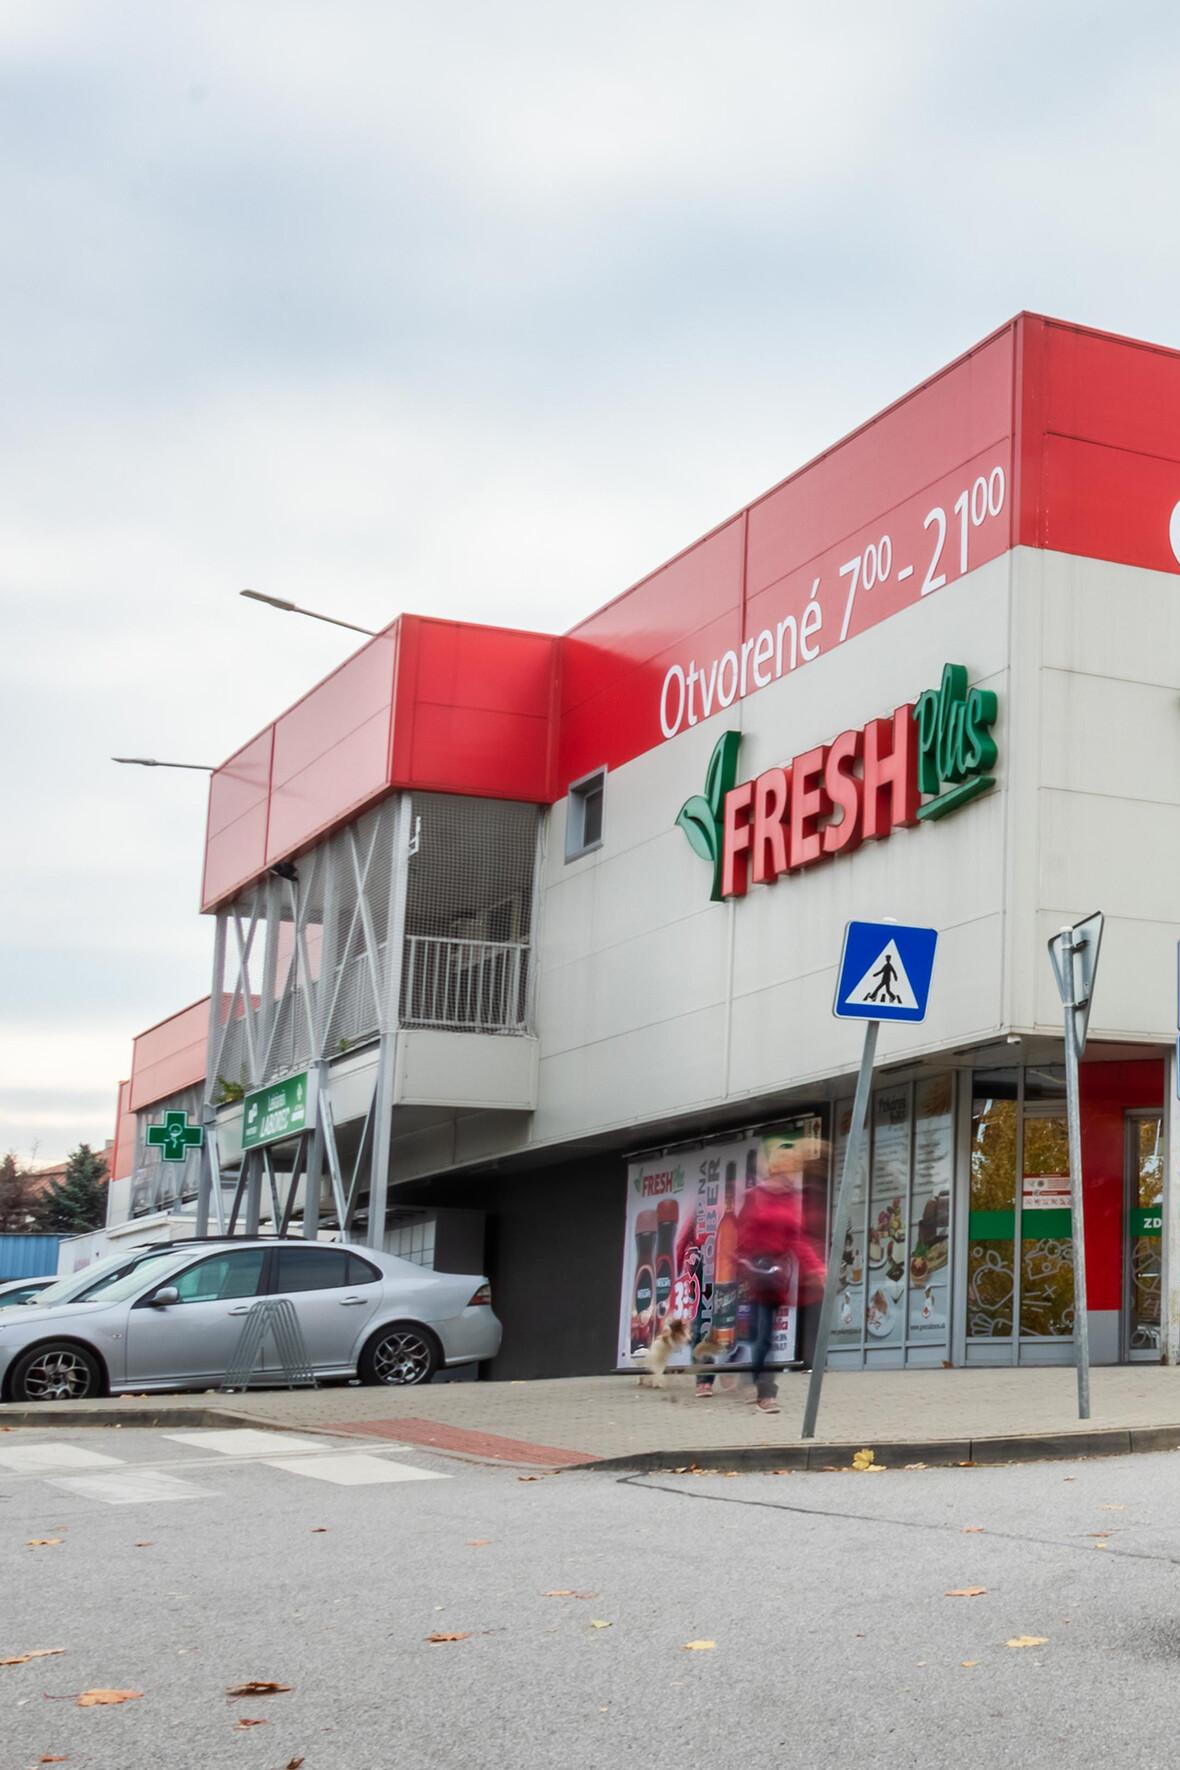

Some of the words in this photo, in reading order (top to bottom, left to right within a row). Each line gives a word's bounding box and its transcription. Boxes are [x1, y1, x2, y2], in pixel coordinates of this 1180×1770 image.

[659, 577, 824, 740] Otvorené
[722, 703, 922, 897] FRESH
[642, 1171, 673, 1197] FRESH
